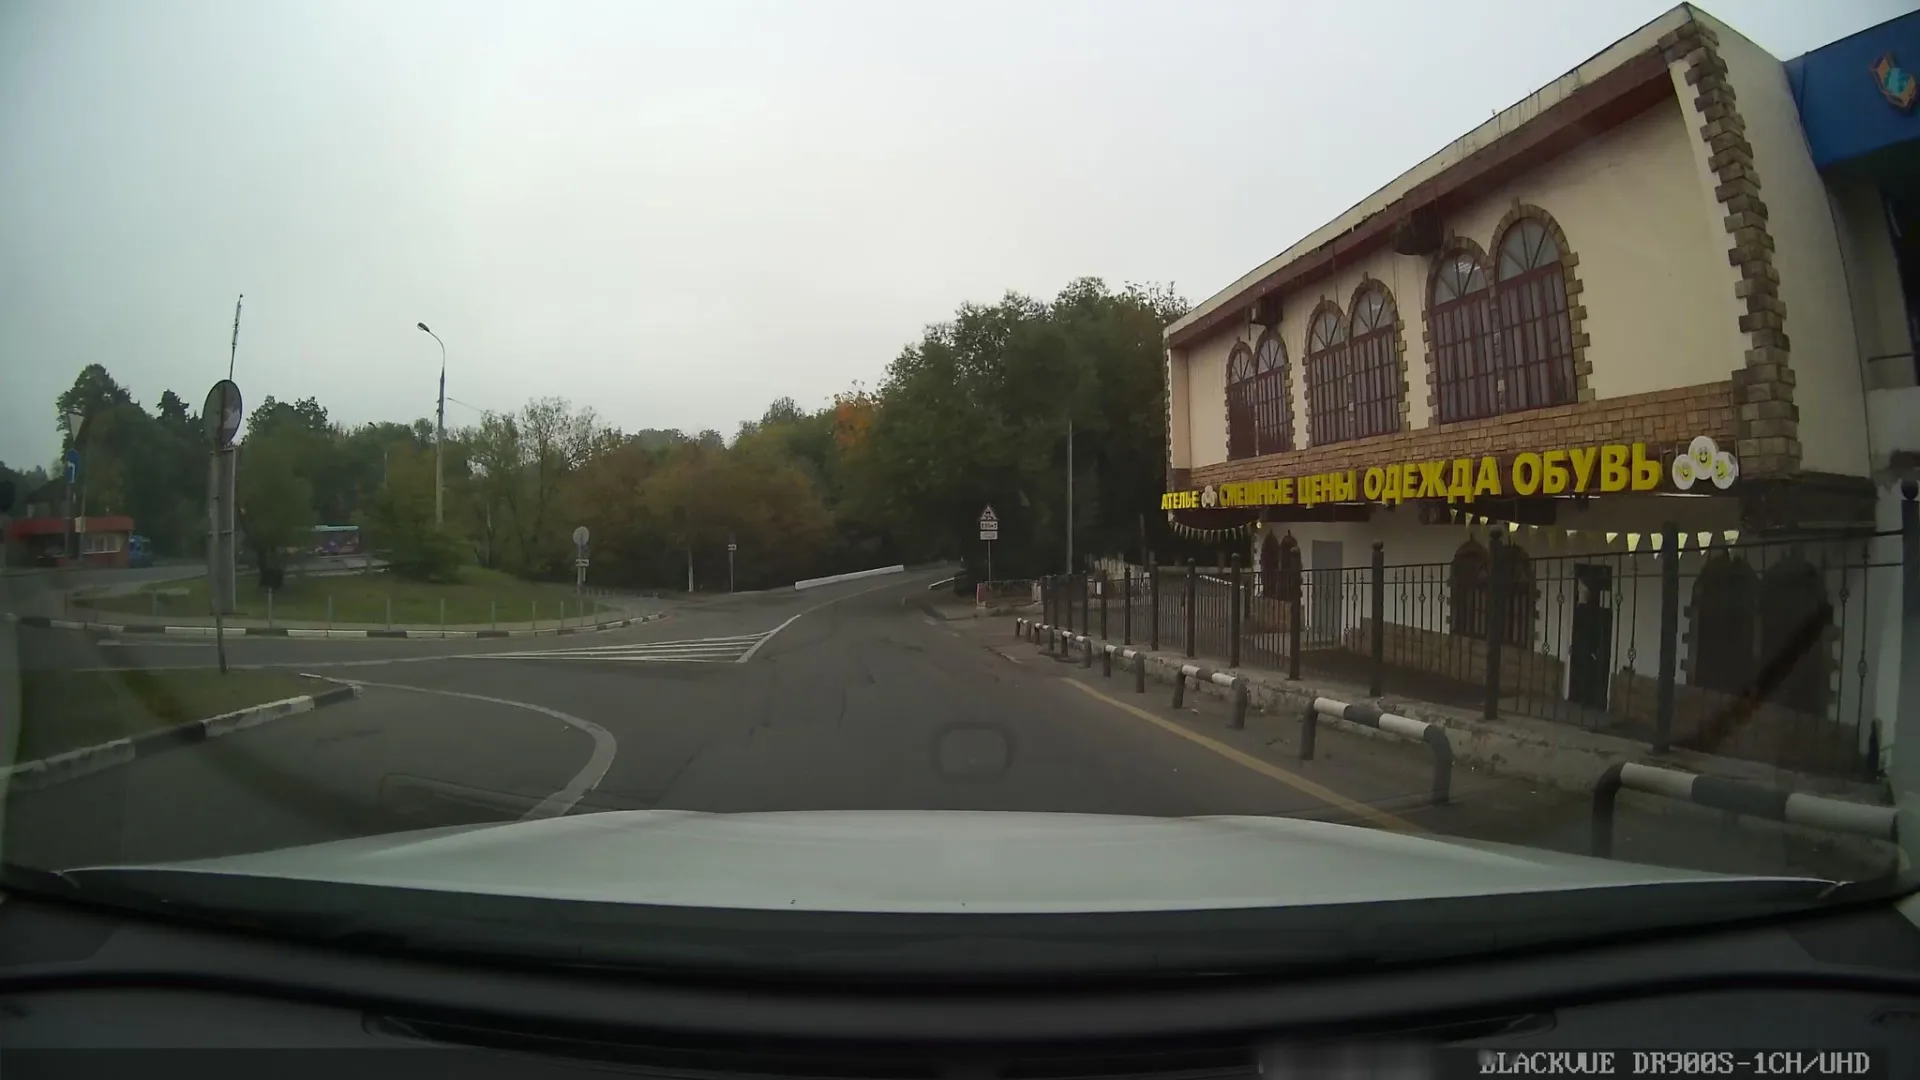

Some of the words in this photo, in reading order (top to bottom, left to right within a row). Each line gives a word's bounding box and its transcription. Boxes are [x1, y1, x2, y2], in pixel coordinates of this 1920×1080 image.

[1161, 490, 1200, 510] АТЕЛЬЕ
[1219, 478, 1294, 507] СМЕШНЫЕ
[1297, 469, 1357, 509] ЦЕНЫ
[1363, 456, 1502, 504] ОДЕЖДА
[1512, 442, 1663, 496] ОБУВЬ
